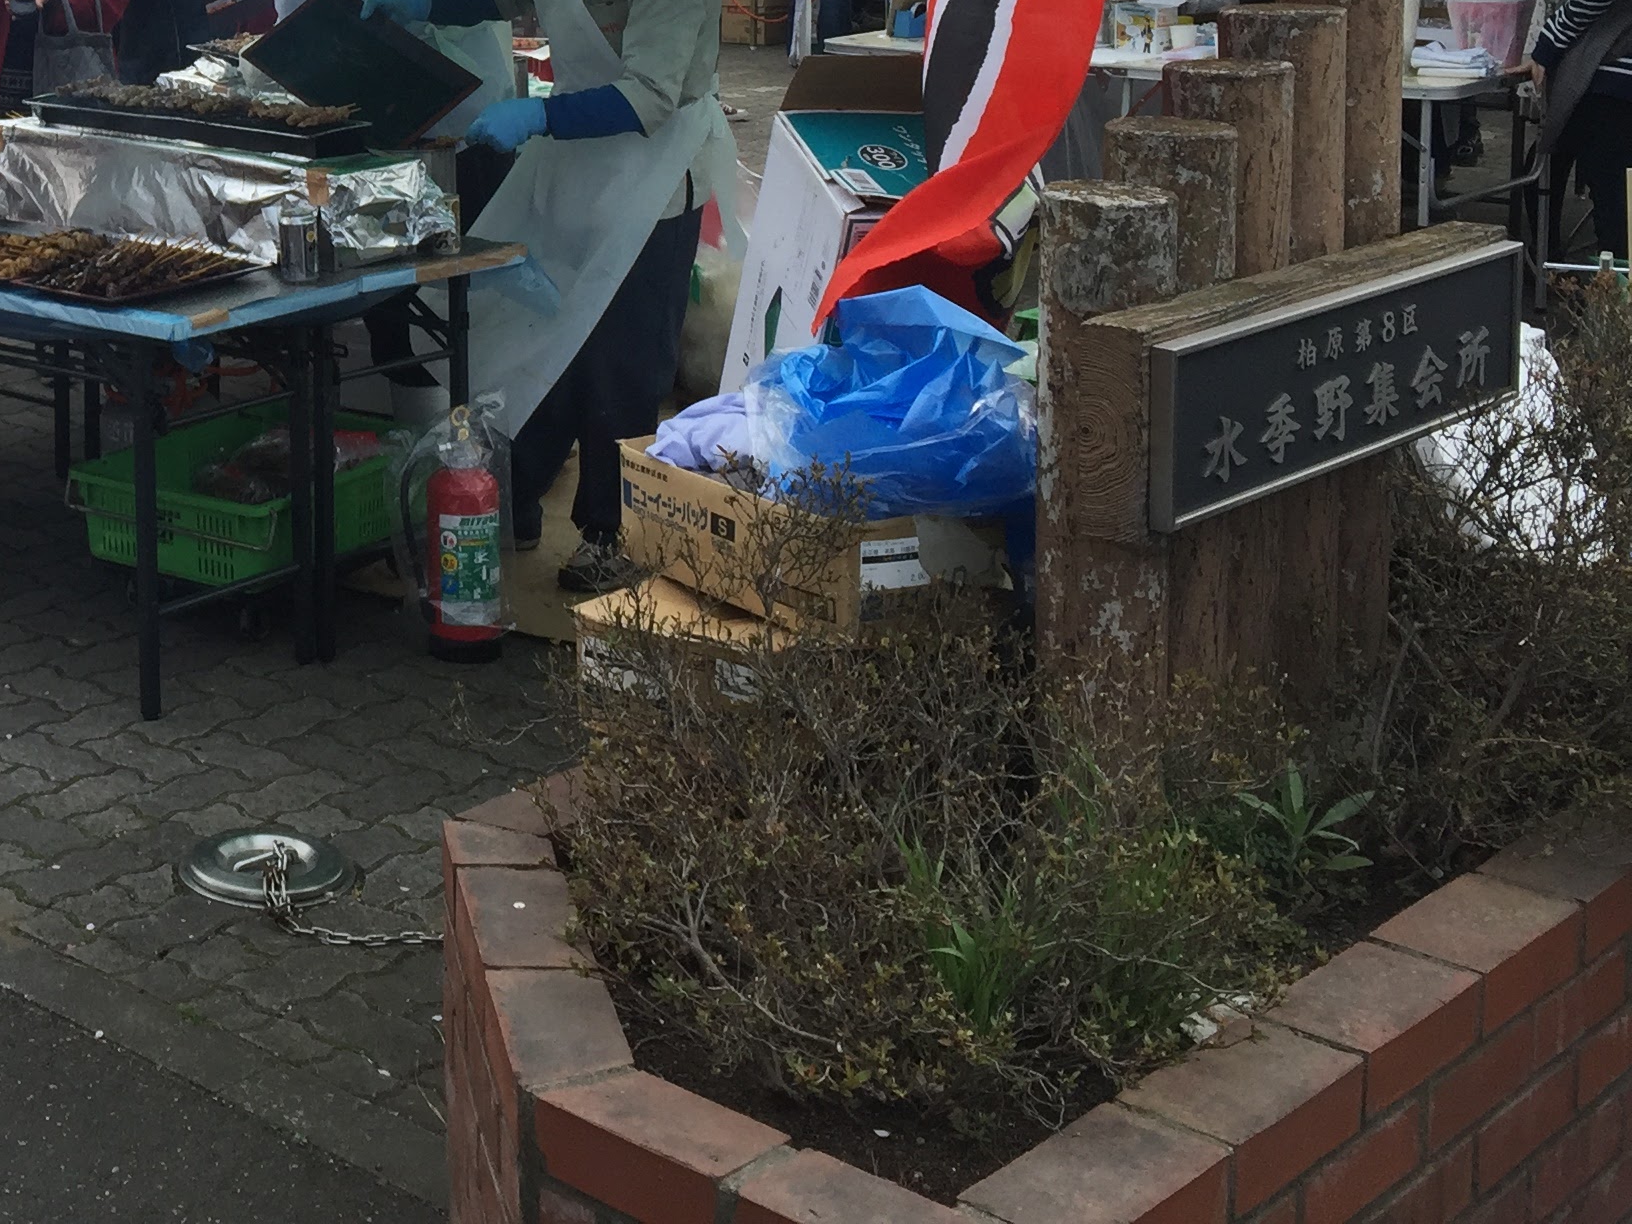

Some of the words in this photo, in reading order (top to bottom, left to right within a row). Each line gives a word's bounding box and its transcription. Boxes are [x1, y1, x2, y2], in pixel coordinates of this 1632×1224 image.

[1297, 303, 1419, 370] 柏原第8区
[1204, 326, 1491, 483] 水季野集会所
